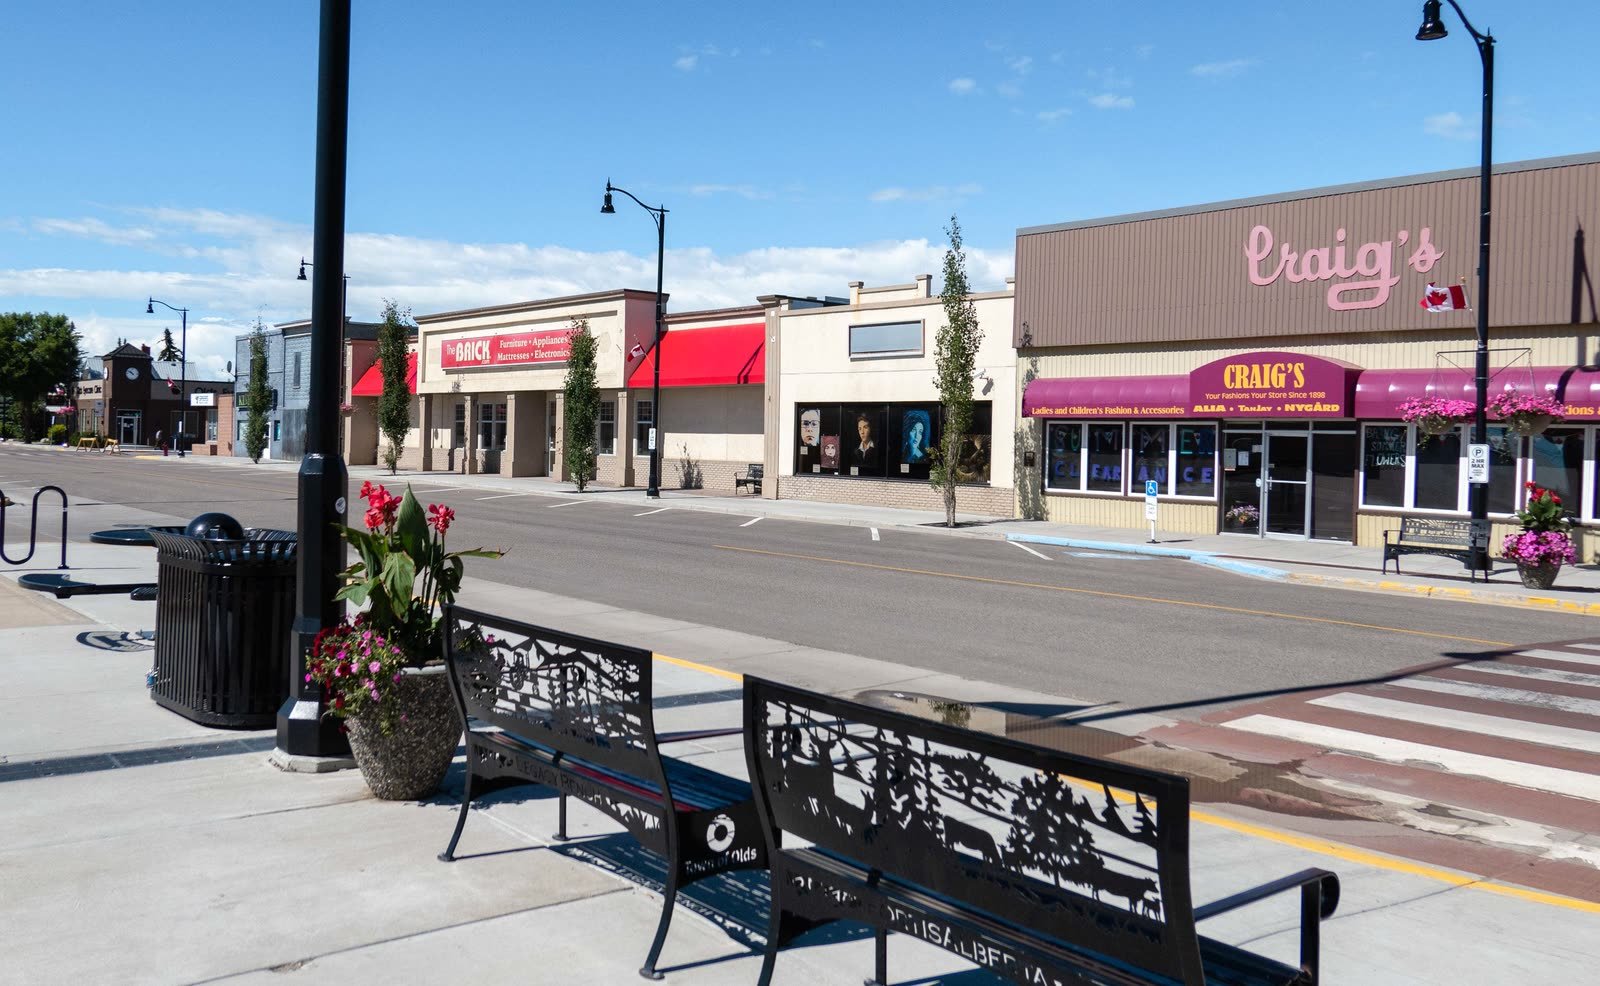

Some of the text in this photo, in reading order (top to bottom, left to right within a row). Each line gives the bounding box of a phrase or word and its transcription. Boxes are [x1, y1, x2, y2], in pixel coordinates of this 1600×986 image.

[1243, 225, 1445, 311] Craig's
[446, 339, 490, 362] The BRICK
[500, 336, 569, 349] Furniture Appliances
[497, 348, 571, 361] Mattresses Electronics
[1223, 362, 1305, 390] CRAIG'S
[1268, 391, 1287, 399] Store
[1288, 391, 1307, 399] Since
[1309, 391, 1326, 399] 1898
[1031, 405, 1185, 415] Ladies and Children's Fashion & Accessories
[1193, 404, 1226, 412] ALIA
[1055, 460, 1214, 484] CLEARANCE
[731, 846, 757, 864] Olds
[867, 901, 1049, 986] ORTISALBERTA
